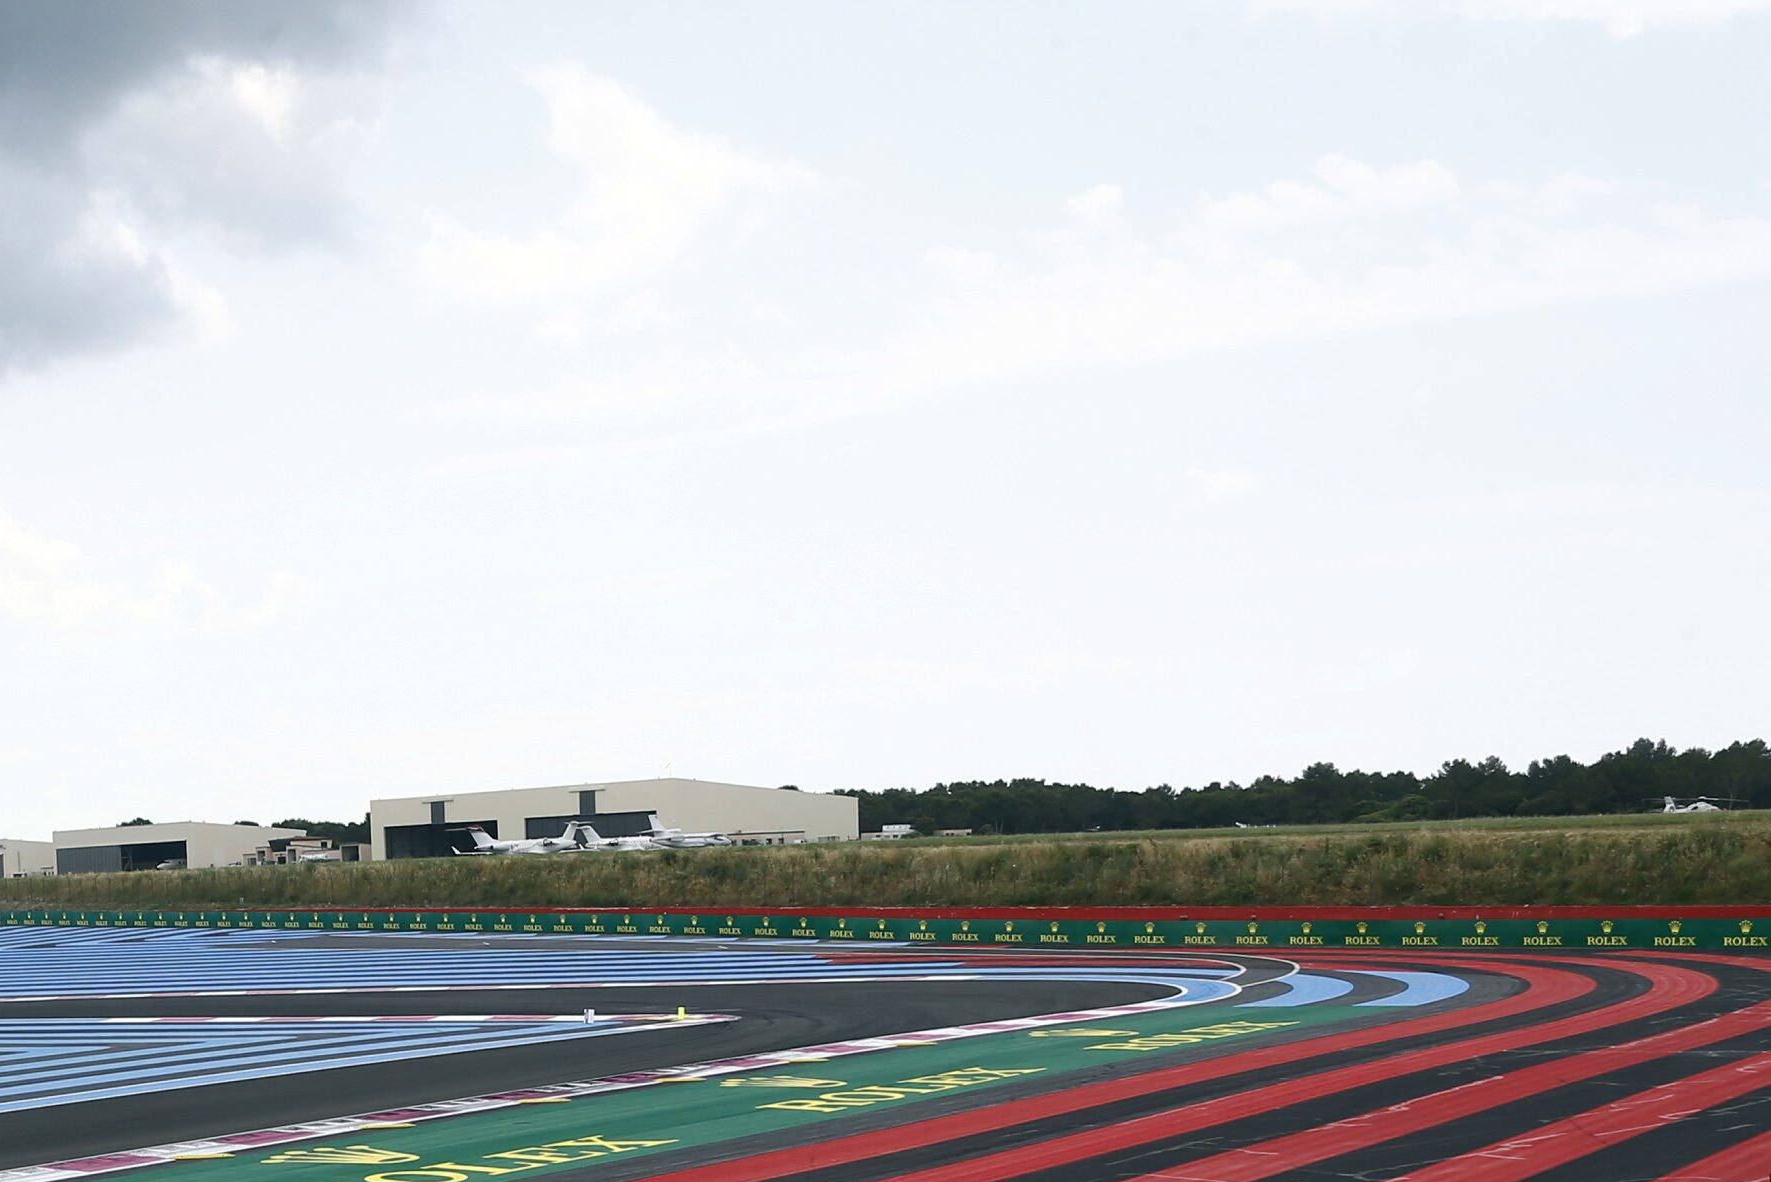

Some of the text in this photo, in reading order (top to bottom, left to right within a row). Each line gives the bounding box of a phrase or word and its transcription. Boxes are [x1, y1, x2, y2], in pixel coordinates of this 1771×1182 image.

[995, 934, 1022, 942] ROLEX
[1185, 936, 1216, 944] ROLEX
[1236, 936, 1268, 944] ROLEX
[1290, 937, 1323, 945] ROLEX
[1345, 937, 1380, 945] ROLEX
[1402, 937, 1437, 945] ROLEX
[1462, 937, 1499, 945] ROLEX
[1524, 937, 1562, 945] ROLEX
[1587, 937, 1627, 945] ROLEX
[1654, 937, 1695, 946] ROLEX
[1724, 937, 1767, 946] ROLEX
[1083, 1020, 1300, 1052] ROLEX
[755, 1066, 1047, 1112] ROLEX
